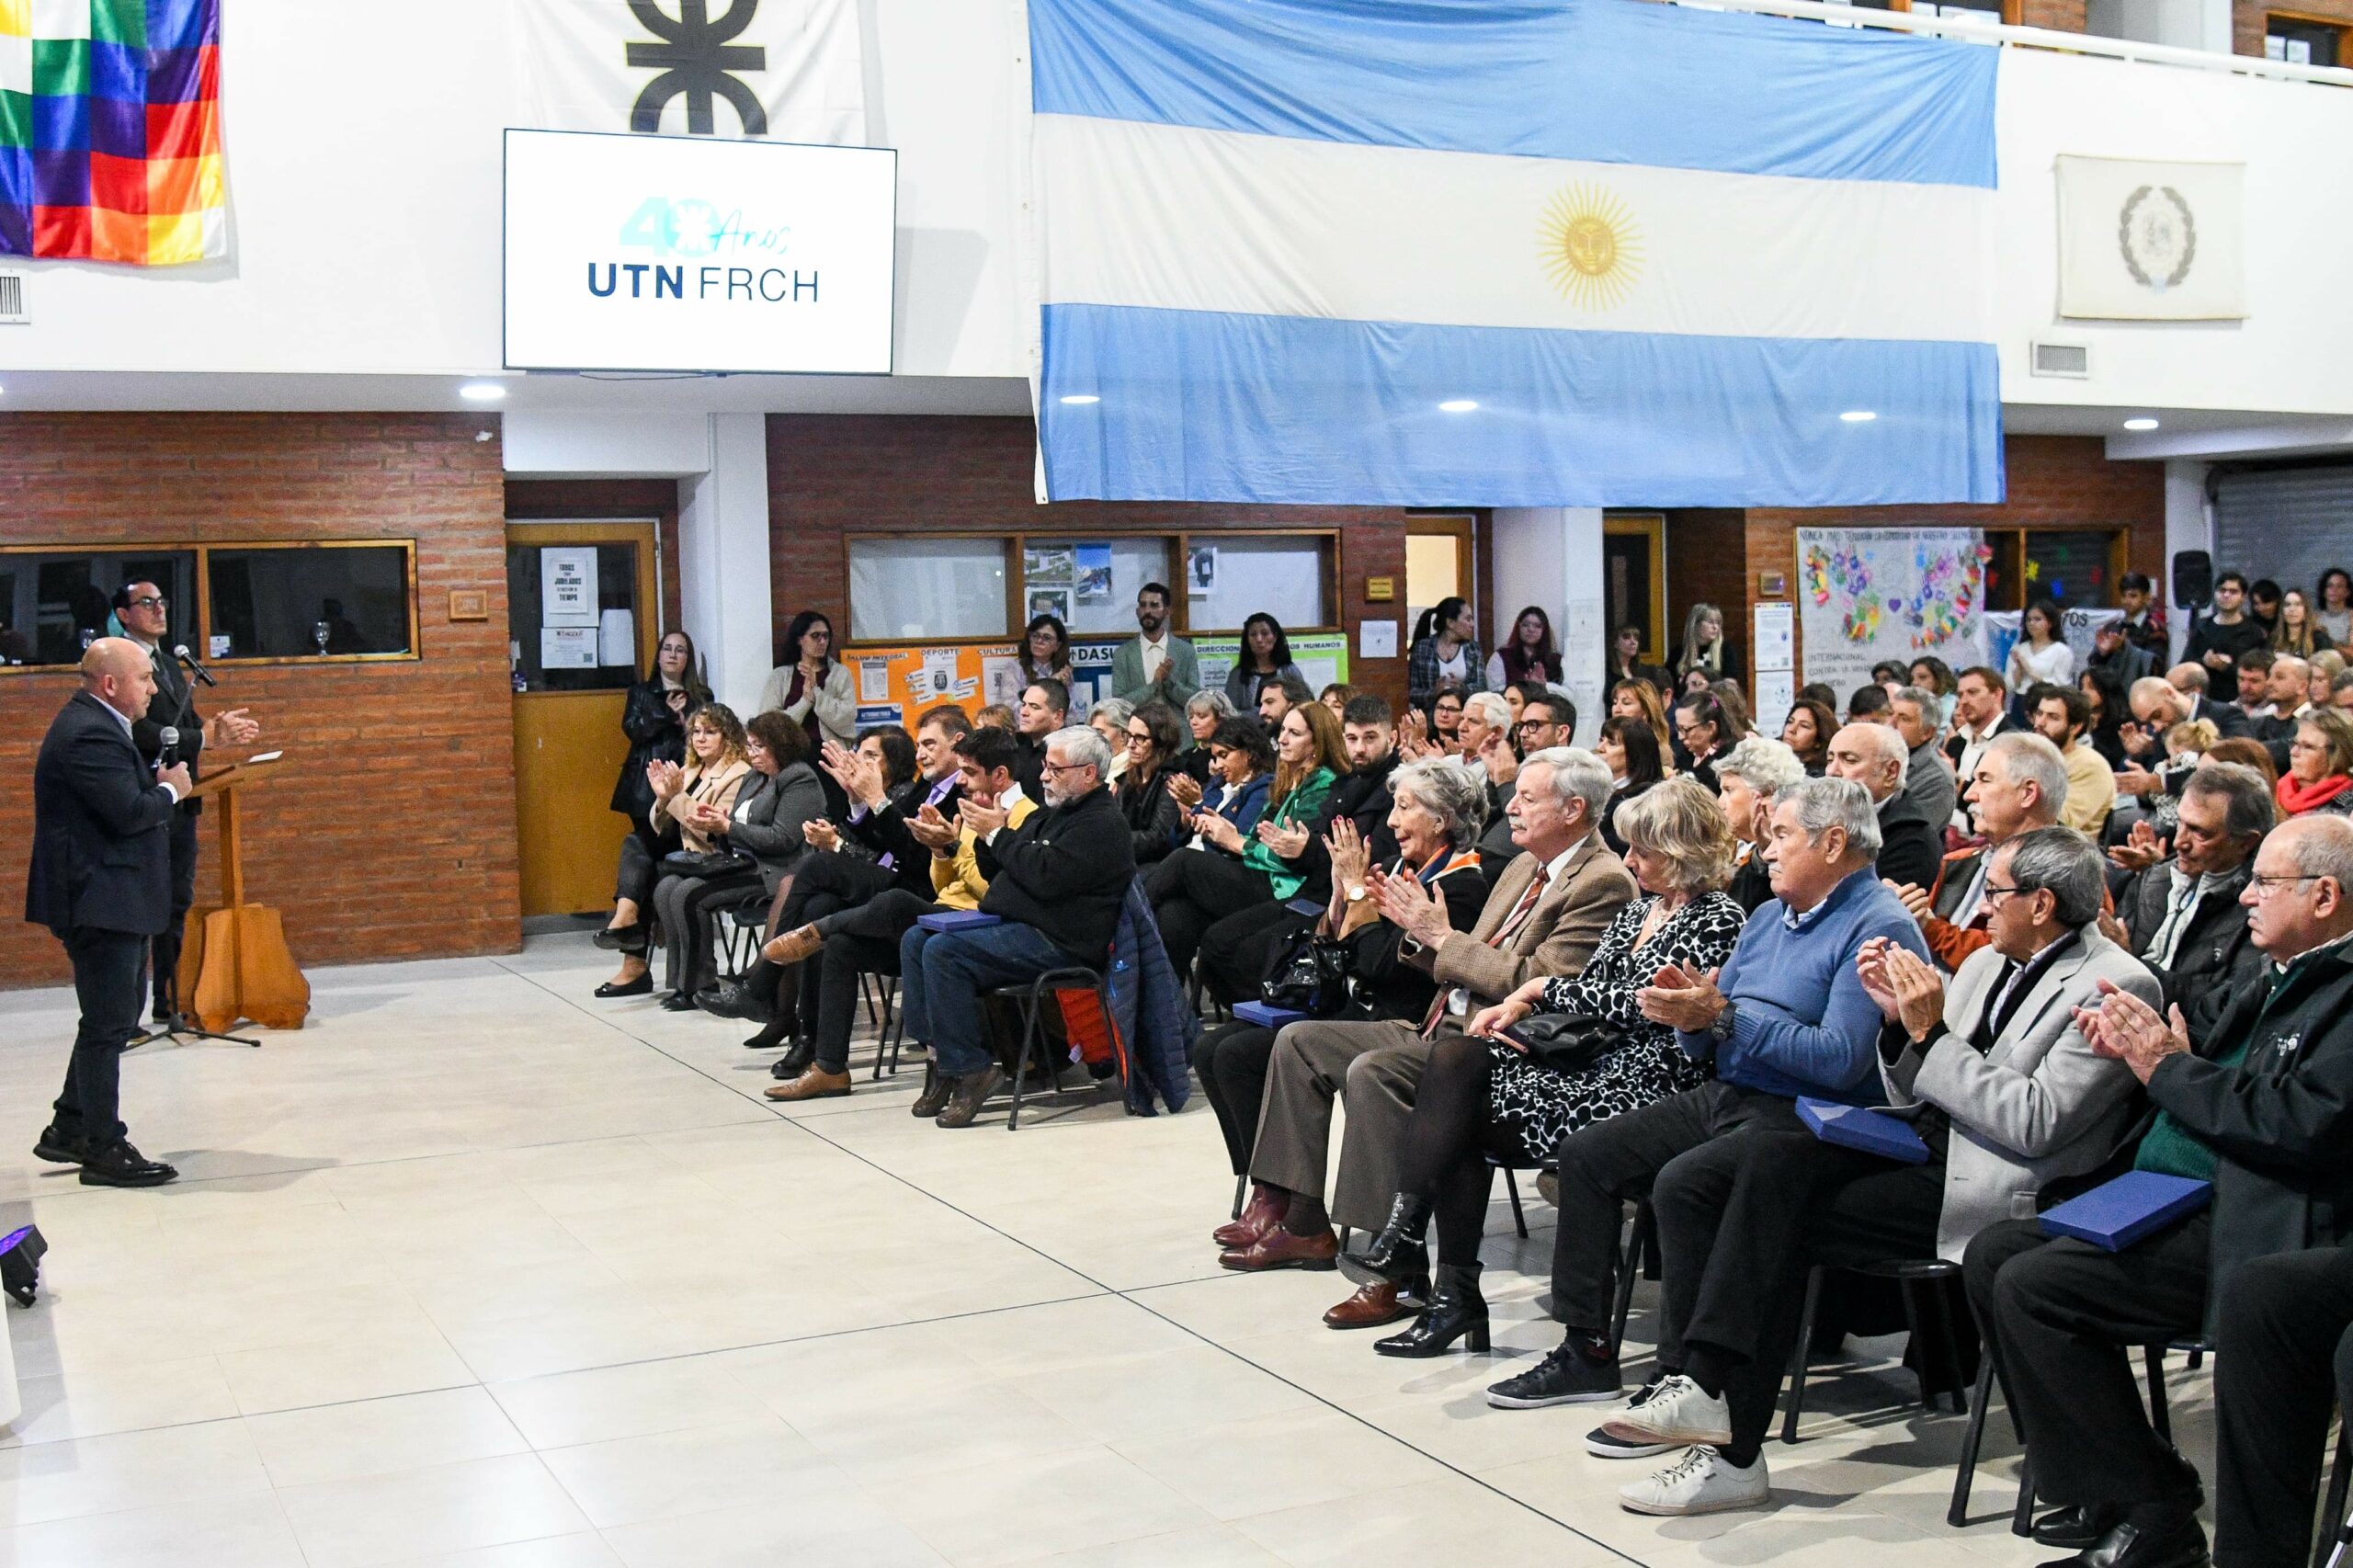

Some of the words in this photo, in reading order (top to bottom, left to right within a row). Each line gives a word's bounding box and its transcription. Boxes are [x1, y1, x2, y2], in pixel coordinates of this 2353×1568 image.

[620, 197, 722, 257] 40
[588, 262, 684, 300] UTN
[700, 267, 818, 302] FRCH
[1303, 642, 1342, 650] HUMANOS
[921, 648, 960, 656] DEPORTE
[978, 647, 1017, 656] CULTURA
